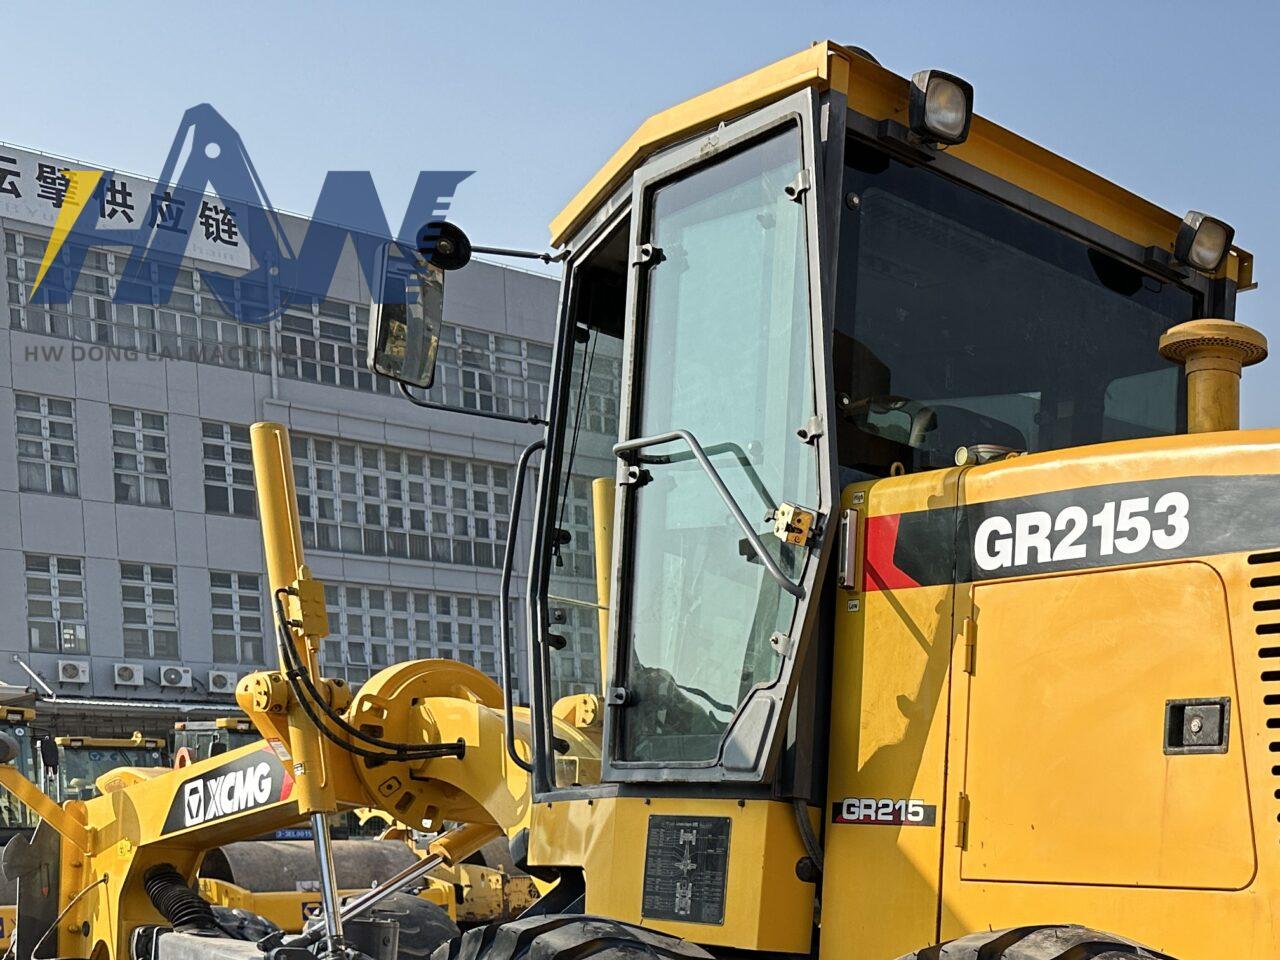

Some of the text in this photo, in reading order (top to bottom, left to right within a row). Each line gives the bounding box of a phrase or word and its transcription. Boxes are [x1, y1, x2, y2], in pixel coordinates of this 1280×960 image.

[974, 491, 1190, 571] GR2153
[205, 762, 272, 820] XCMG
[842, 798, 924, 822] GR215
